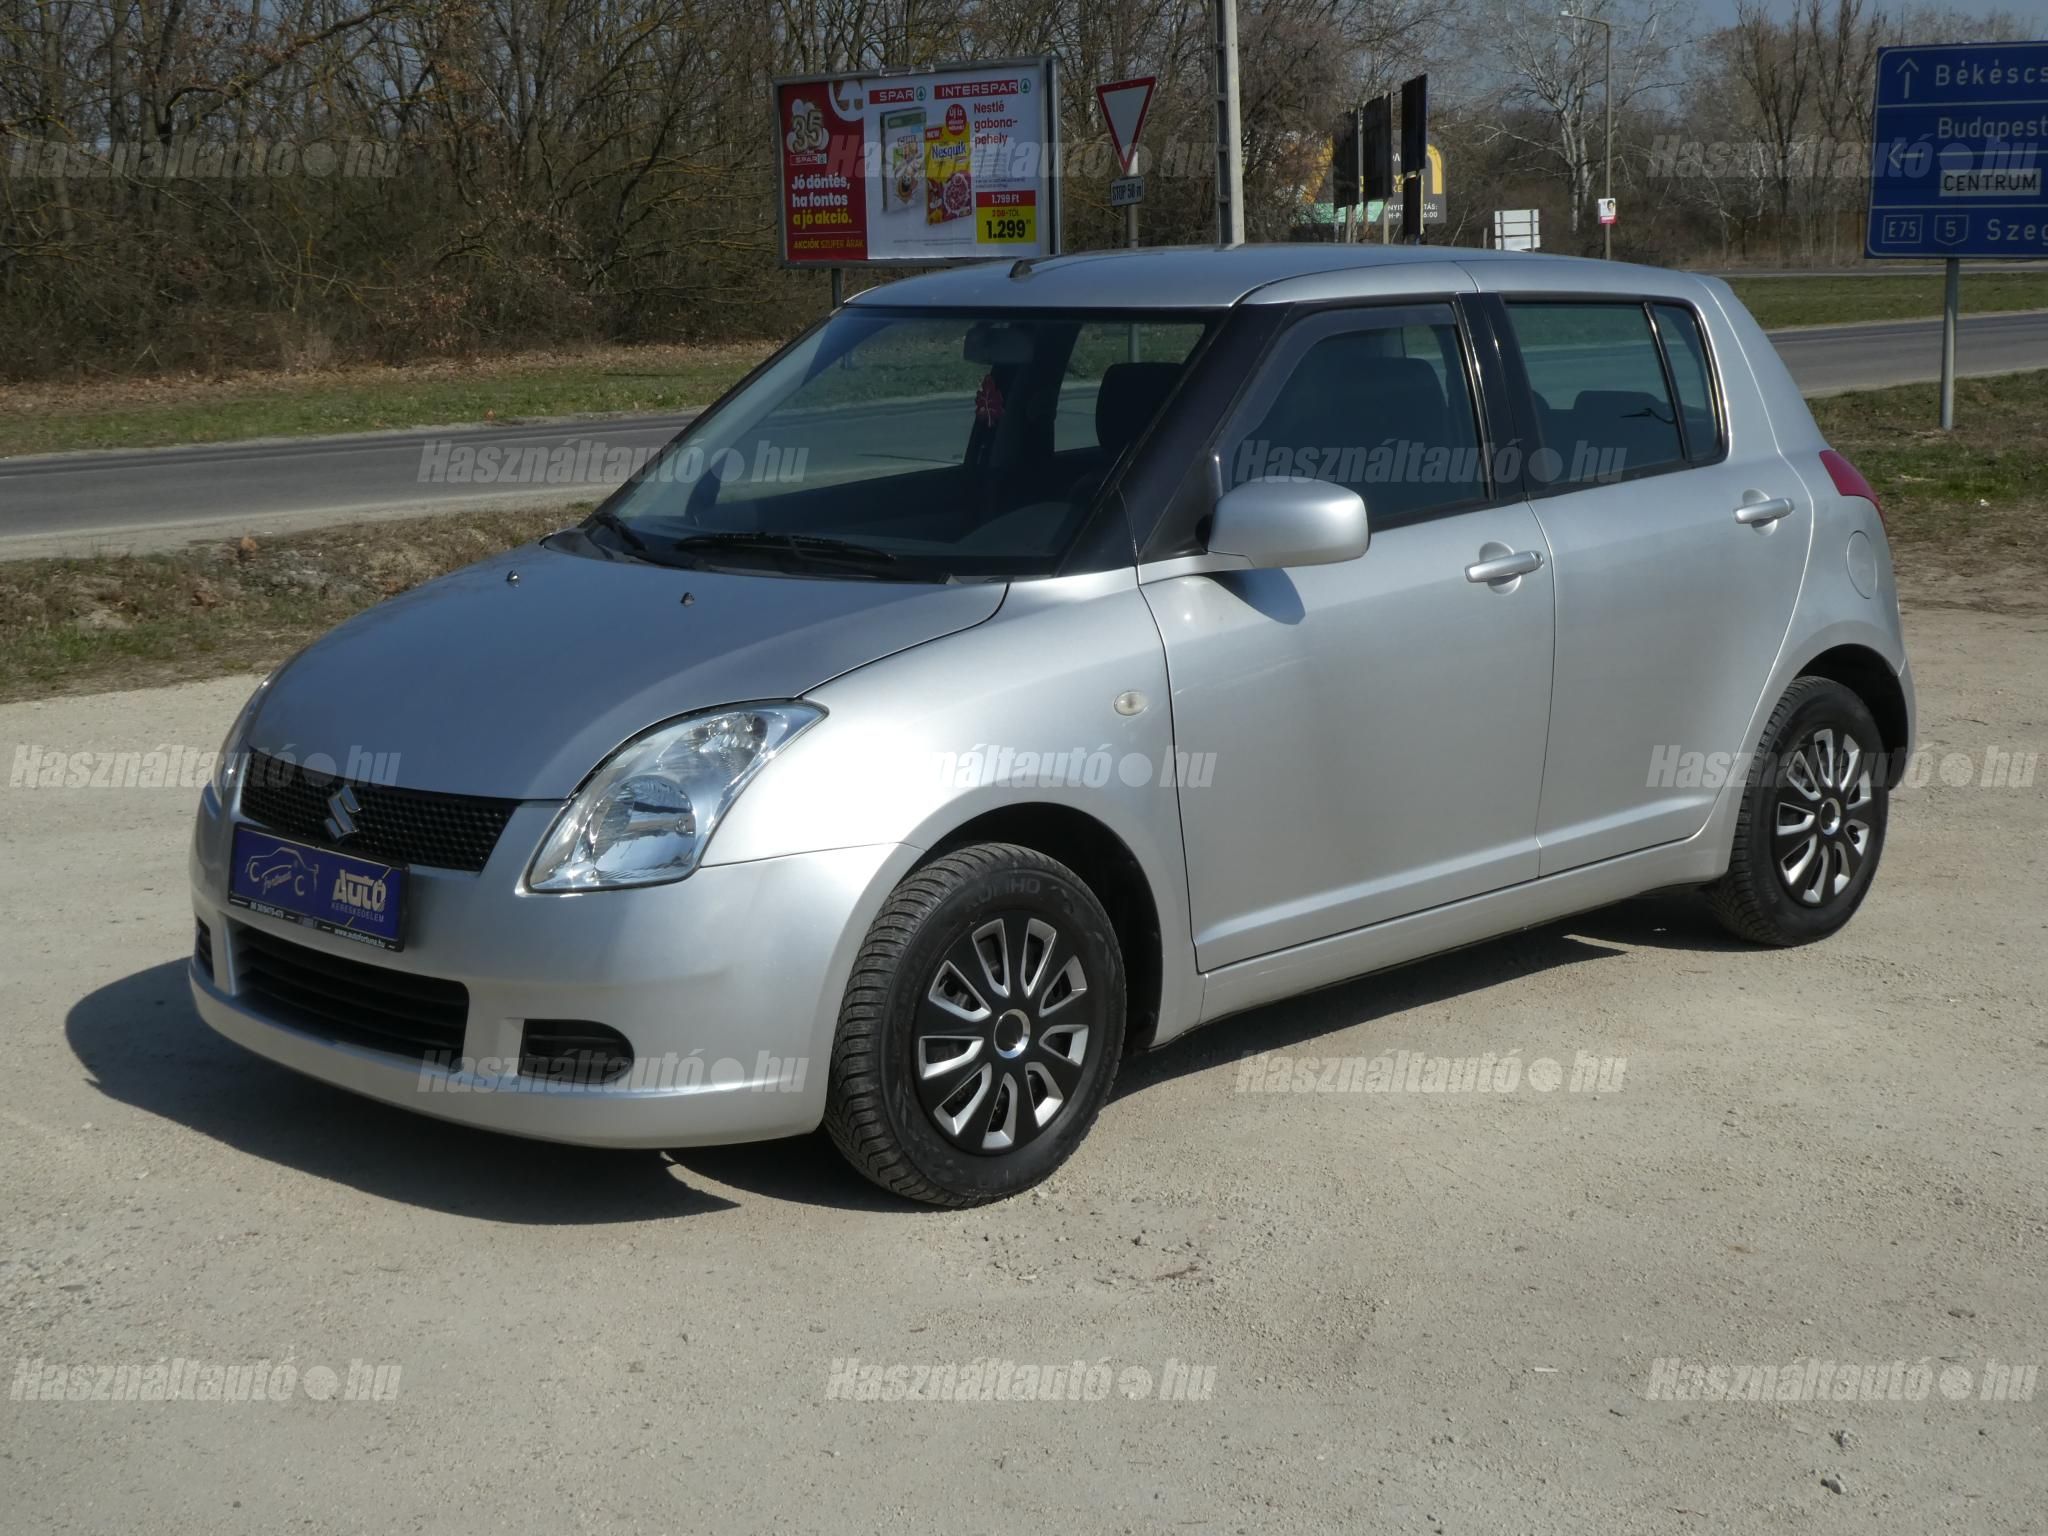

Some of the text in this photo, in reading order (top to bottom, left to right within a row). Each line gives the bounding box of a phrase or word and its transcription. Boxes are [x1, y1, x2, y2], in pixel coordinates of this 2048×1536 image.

[879, 90, 914, 103] SPAR
[941, 81, 1018, 98] INTERSPAR
[973, 100, 1004, 114] Nestlé
[974, 117, 1018, 134] gabona-
[1938, 115, 2048, 143] Budapest
[975, 132, 1008, 149] pehely
[931, 142, 966, 160] Nesquik
[791, 172, 850, 191] Jó döntés,
[1943, 173, 2037, 192] CENTRUM
[792, 192, 848, 208] ha fontos
[1112, 185, 1126, 201] STOP
[792, 208, 853, 230] a jó akció.
[986, 218, 1026, 239] 1.299
[1945, 221, 1957, 238] 5
